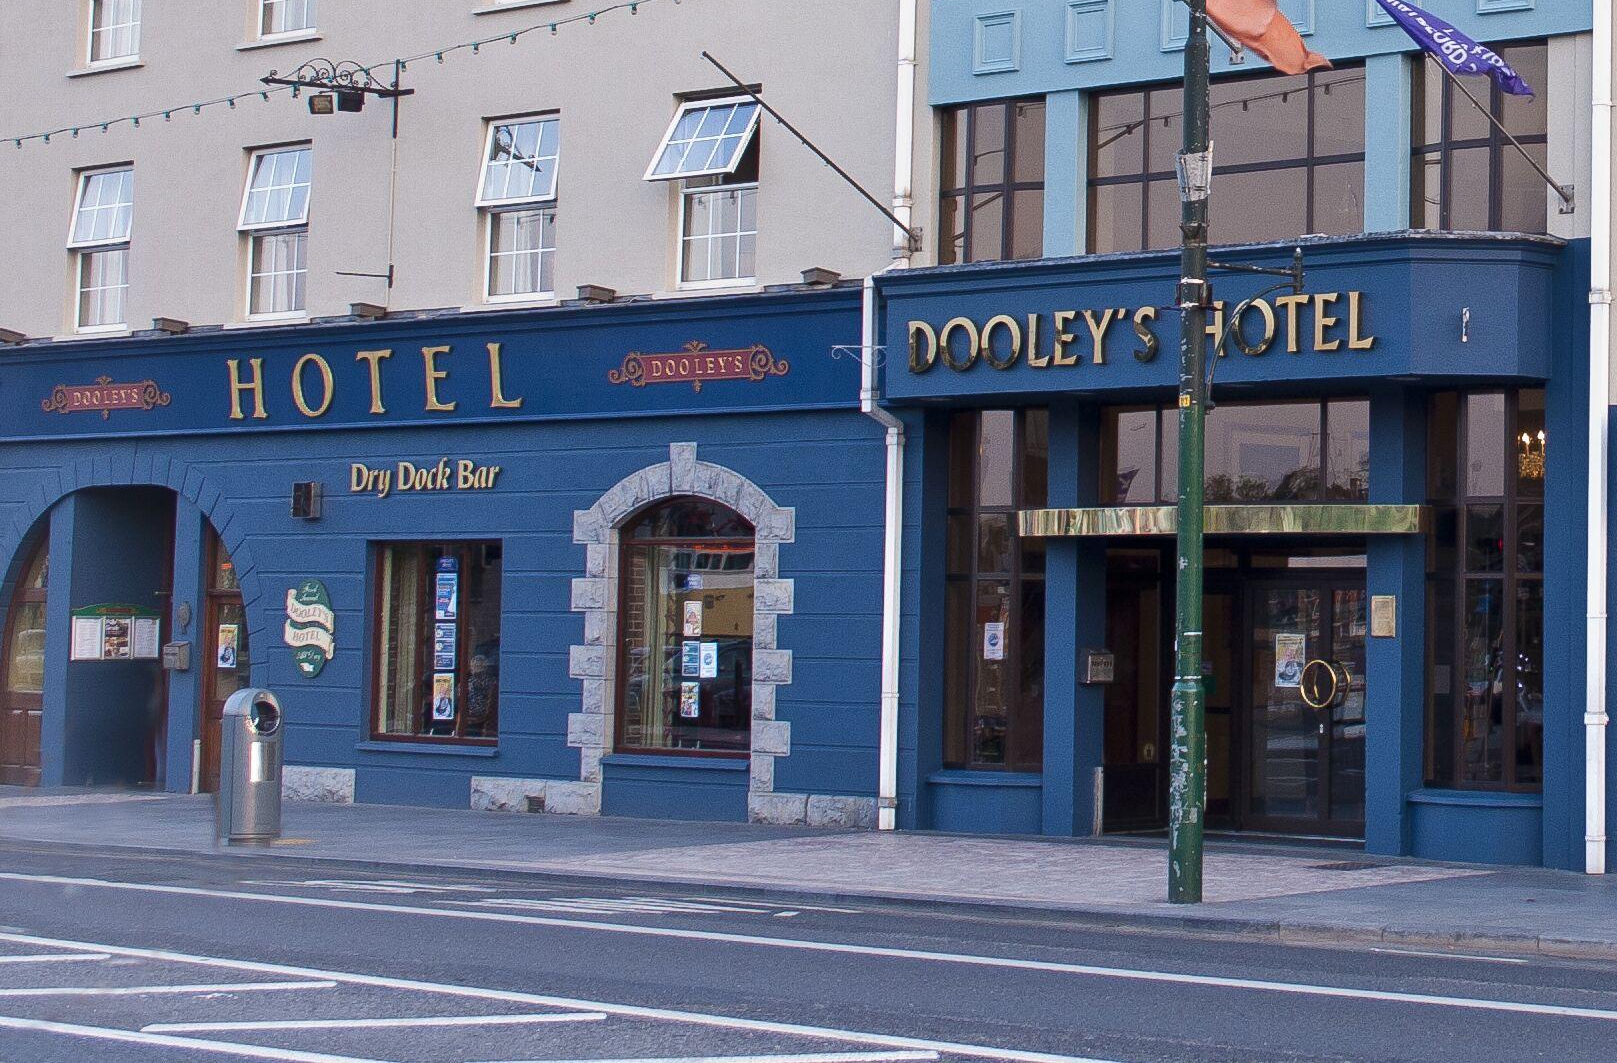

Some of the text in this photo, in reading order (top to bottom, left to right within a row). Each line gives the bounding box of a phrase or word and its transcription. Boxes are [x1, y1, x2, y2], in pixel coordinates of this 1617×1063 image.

[908, 305, 1160, 373] DOOLEY'S
[226, 341, 523, 419] HOTEL
[651, 355, 743, 377] DOOLEY'S
[73, 388, 138, 406] DOOLEY'S
[351, 457, 500, 498] Dry Dock Bar
[292, 630, 321, 642] HOTEL
